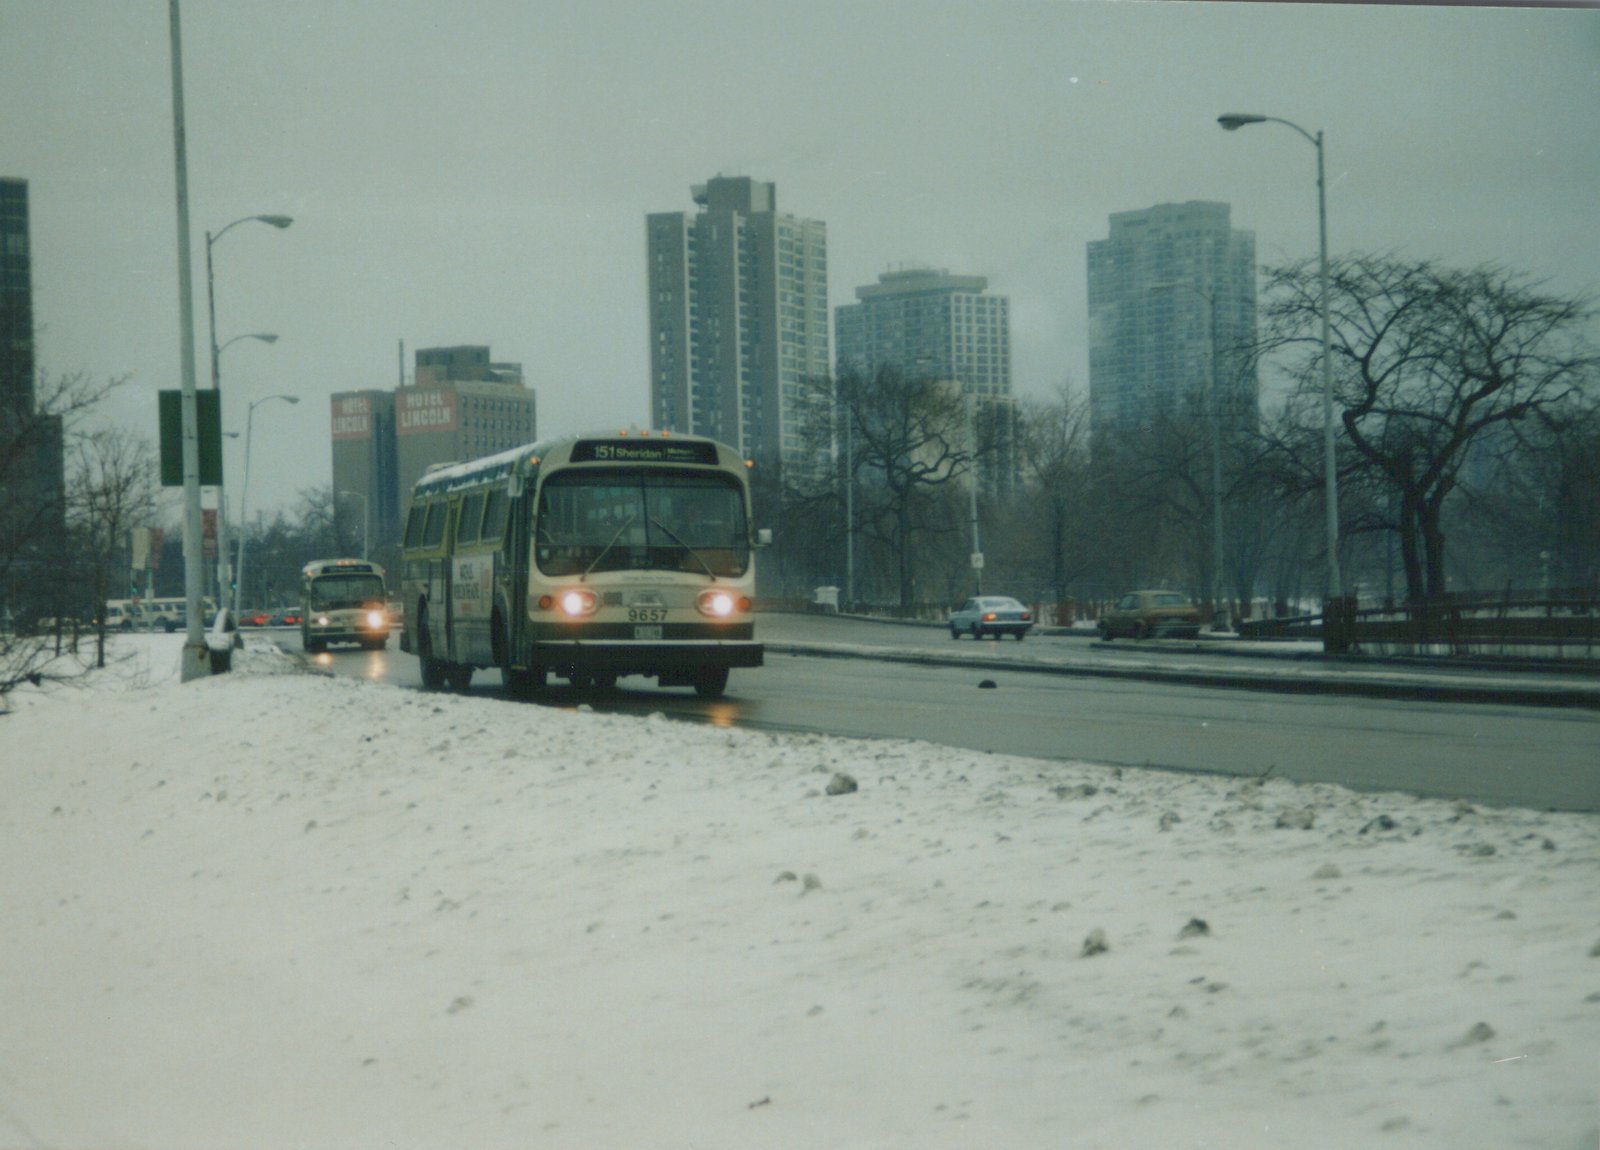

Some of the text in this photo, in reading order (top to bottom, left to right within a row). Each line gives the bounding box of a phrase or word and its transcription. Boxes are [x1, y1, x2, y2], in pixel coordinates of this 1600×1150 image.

[342, 397, 369, 414] HOTEL
[406, 392, 444, 409] HOTEL
[333, 415, 368, 434] LINCOLN
[401, 407, 450, 427] LINCOLN
[595, 445, 615, 459] 151
[616, 447, 662, 459] Sheridan
[628, 609, 668, 622] 9657
